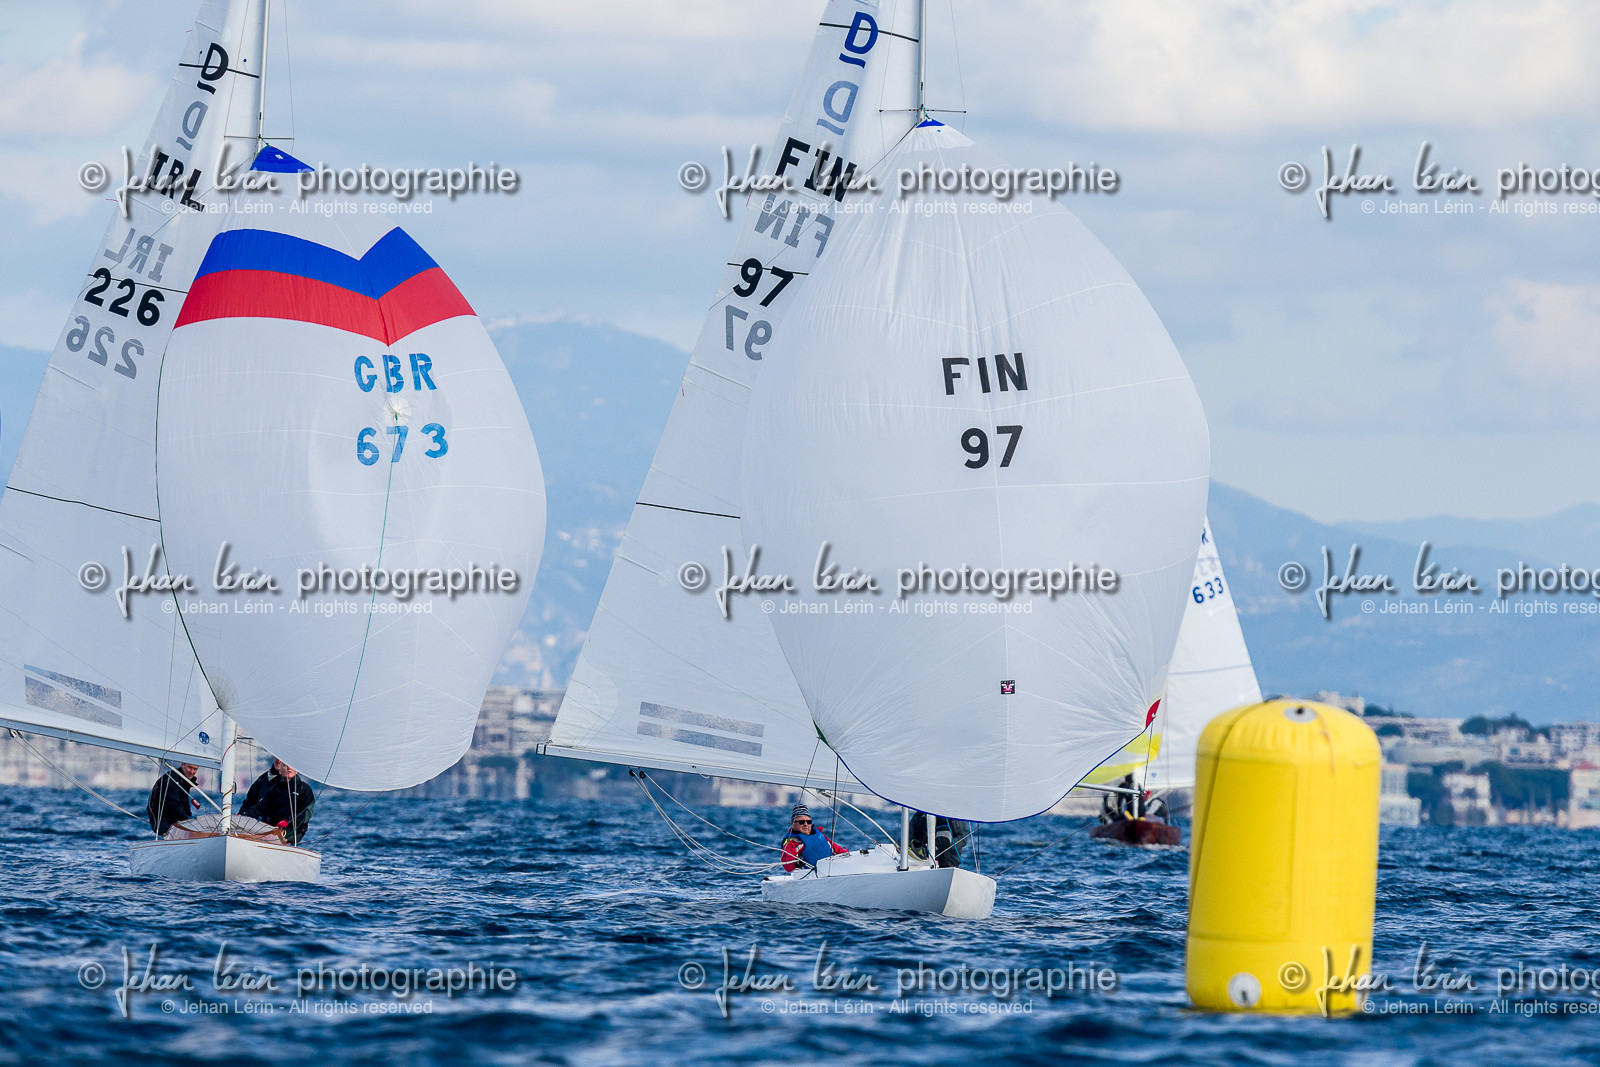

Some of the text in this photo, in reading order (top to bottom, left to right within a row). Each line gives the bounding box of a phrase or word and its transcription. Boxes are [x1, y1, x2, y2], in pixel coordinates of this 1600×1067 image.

[844, 11, 878, 54] D
[200, 42, 229, 81] D
[145, 152, 205, 212] IRL
[775, 137, 857, 202] FIN
[84, 268, 165, 326] 226
[733, 258, 794, 307] 97
[354, 353, 437, 393] GBR
[942, 353, 1028, 395] FIN
[357, 423, 449, 466] 673
[961, 425, 1023, 469] 97
[1193, 577, 1223, 603] 633
